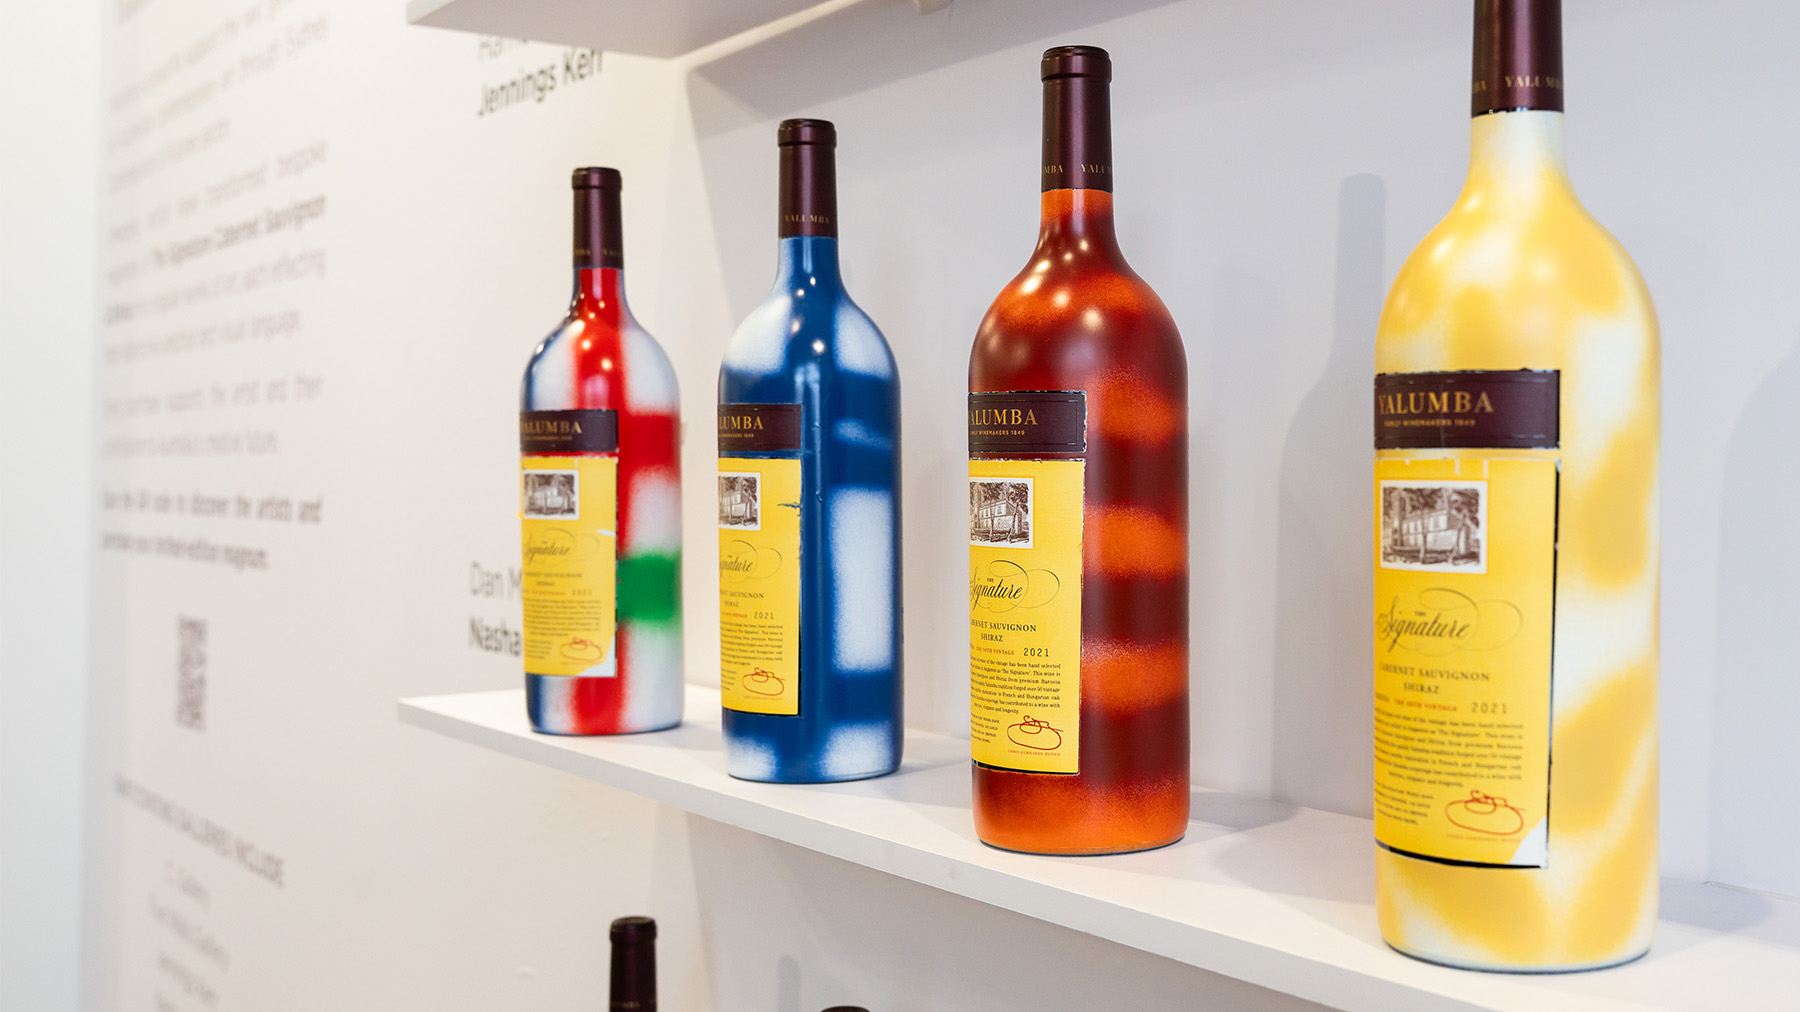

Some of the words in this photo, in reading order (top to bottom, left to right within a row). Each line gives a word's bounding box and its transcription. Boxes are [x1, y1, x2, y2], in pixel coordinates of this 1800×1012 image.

[478, 66, 557, 118] Jennings
[1377, 391, 1495, 415] YALUMBA
[719, 416, 764, 430] LUMBA
[970, 408, 1038, 425] ALUMBA
[520, 420, 583, 434] ALUMBA
[470, 561, 505, 600] Dan
[509, 565, 523, 601] M
[754, 611, 774, 620] 2021
[989, 622, 1037, 632] SAUVIGNON
[469, 614, 522, 658] Nasha
[980, 633, 1003, 642] SHIRAZ
[1023, 647, 1050, 658] 2021
[1419, 667, 1490, 681] SAUVIGNON
[1403, 682, 1440, 695] SHIRAZ
[1471, 702, 1507, 715] 2021
